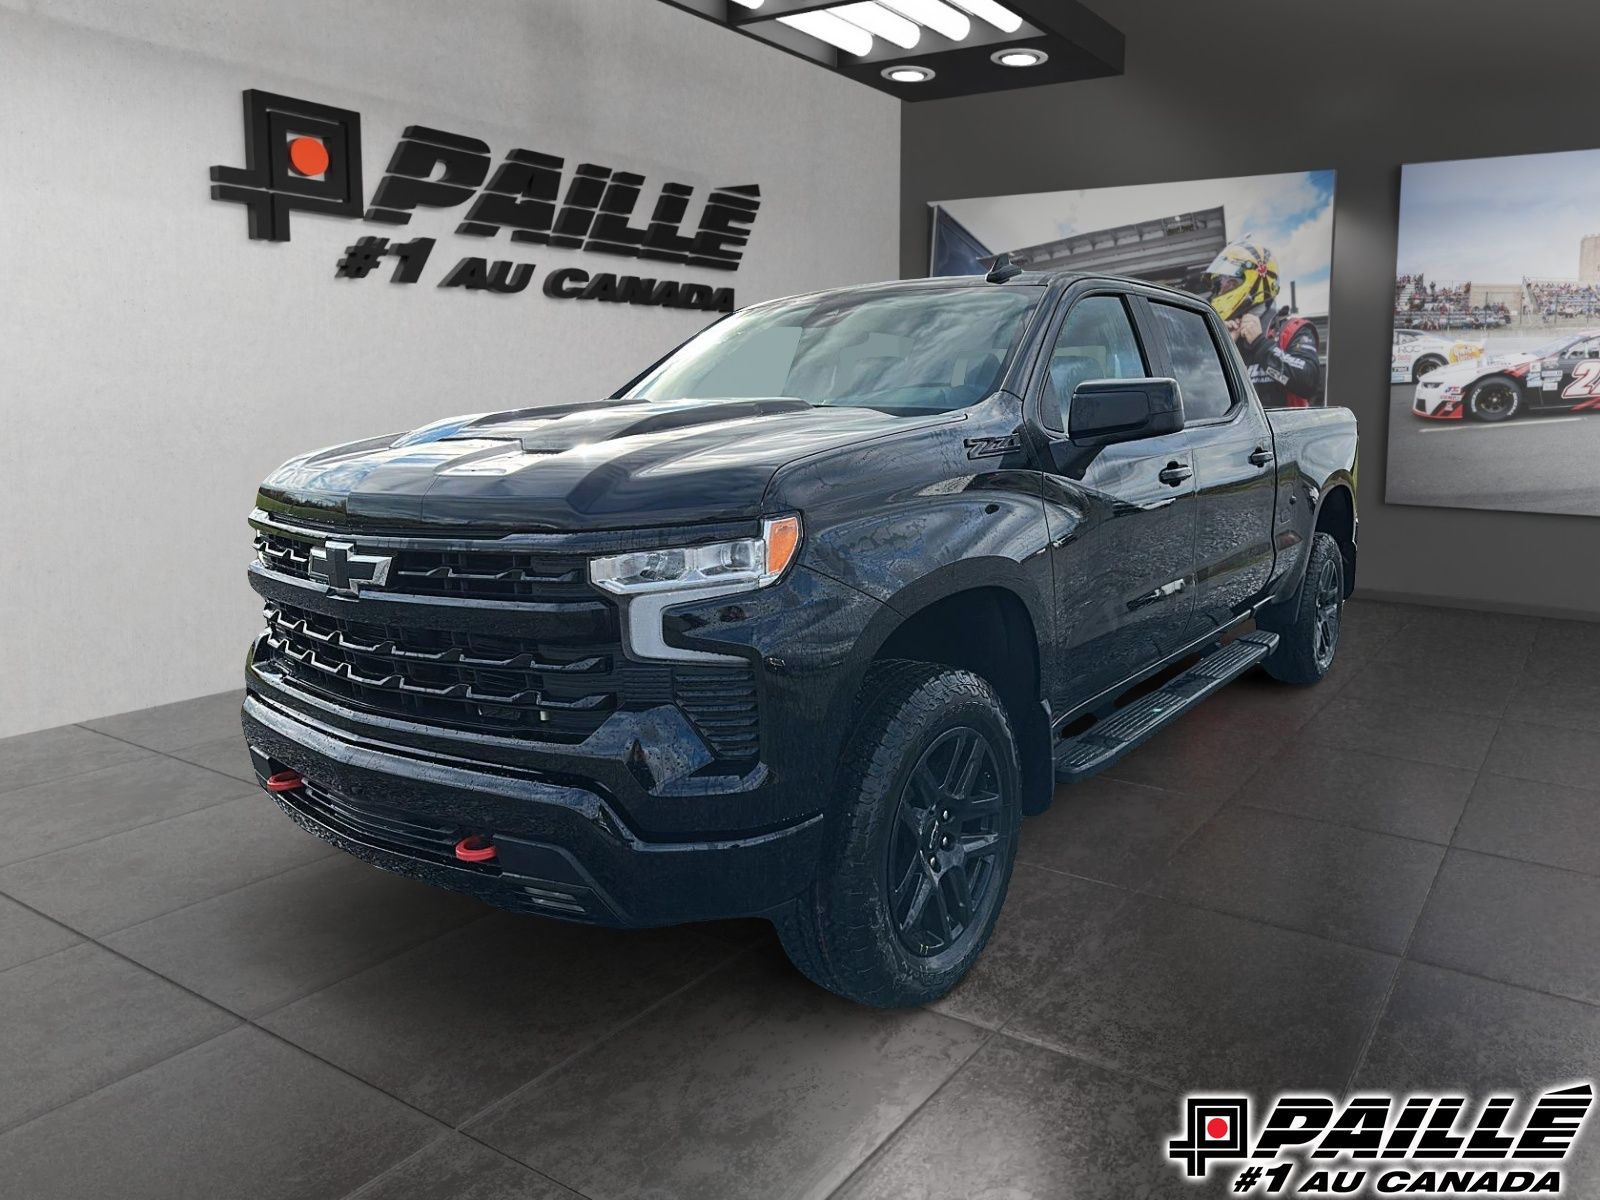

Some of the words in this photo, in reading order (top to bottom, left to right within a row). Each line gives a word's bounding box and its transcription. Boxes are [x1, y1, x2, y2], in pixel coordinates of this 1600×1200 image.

[363, 125, 761, 271] PAILLÉ
[335, 236, 436, 284] #1
[437, 257, 536, 294] AU
[543, 268, 735, 313] CANADA
